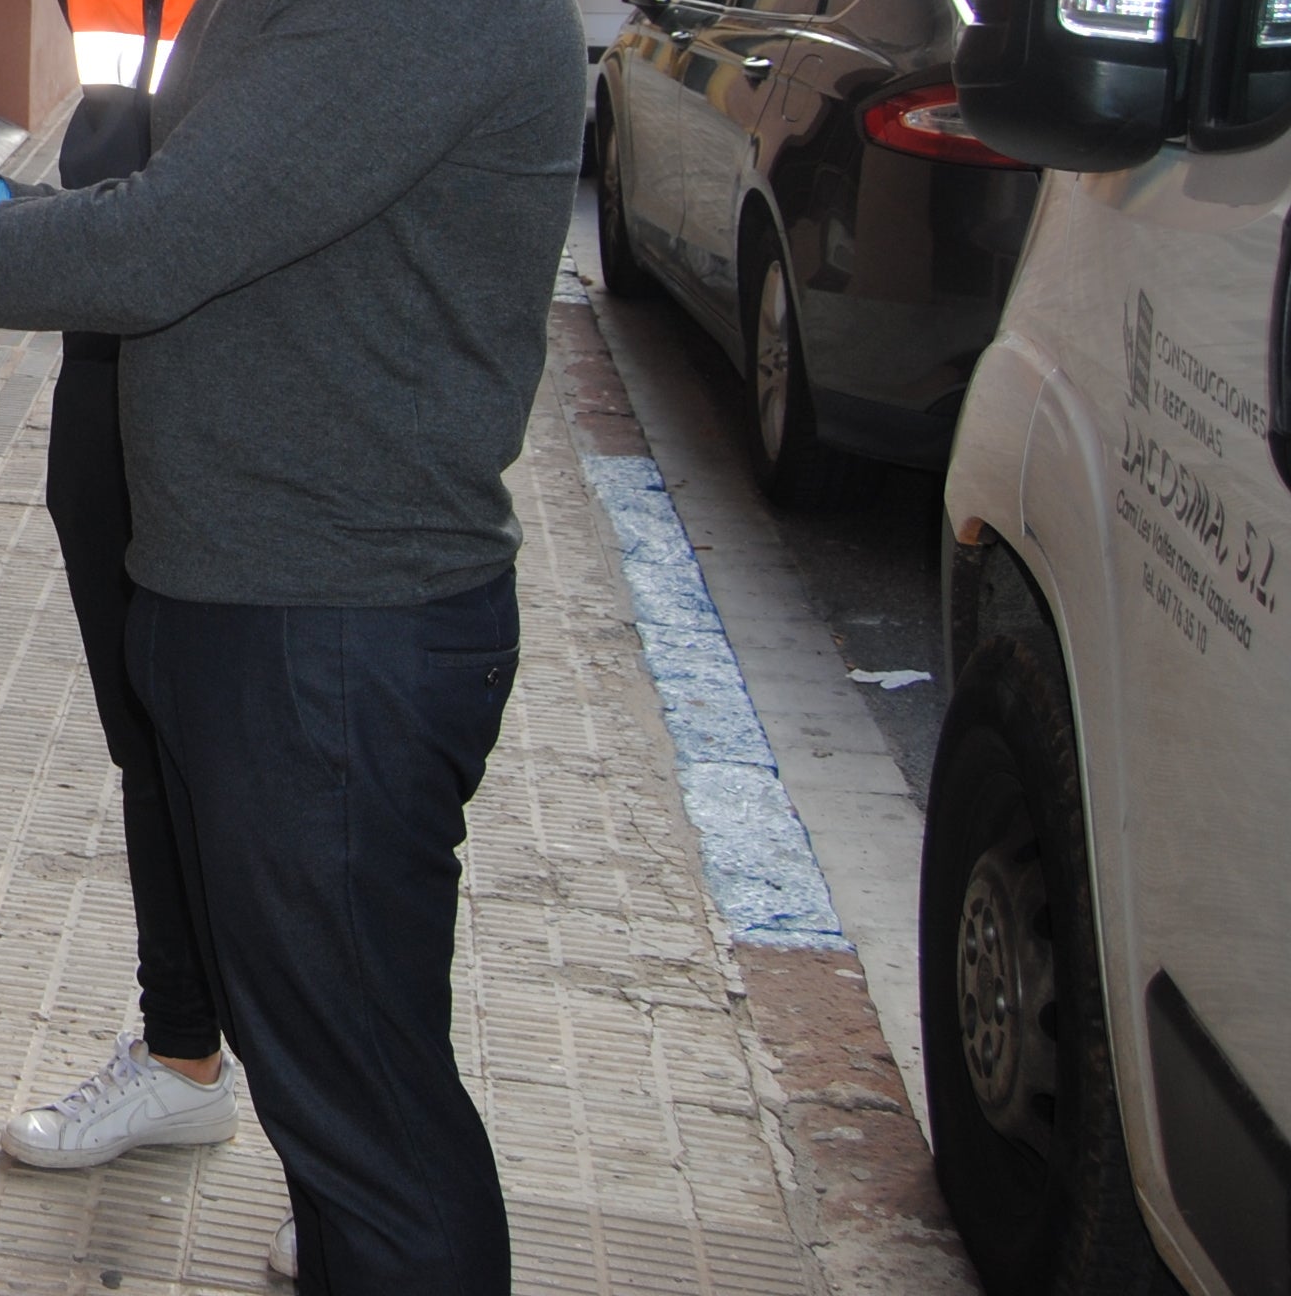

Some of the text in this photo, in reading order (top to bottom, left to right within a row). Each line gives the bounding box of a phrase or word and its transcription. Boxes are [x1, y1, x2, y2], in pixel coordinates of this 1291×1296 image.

[1154, 376, 1223, 459] Y REFORMAS
[1155, 330, 1268, 441] CONSTRUCCIONES
[1138, 508, 1151, 544] Les
[1176, 554, 1199, 593] nave
[1199, 574, 1208, 601] 4
[1207, 579, 1253, 651] izquierda
[1156, 578, 1172, 615] 647
[1172, 594, 1183, 628] 76
[1196, 620, 1207, 655] 10
